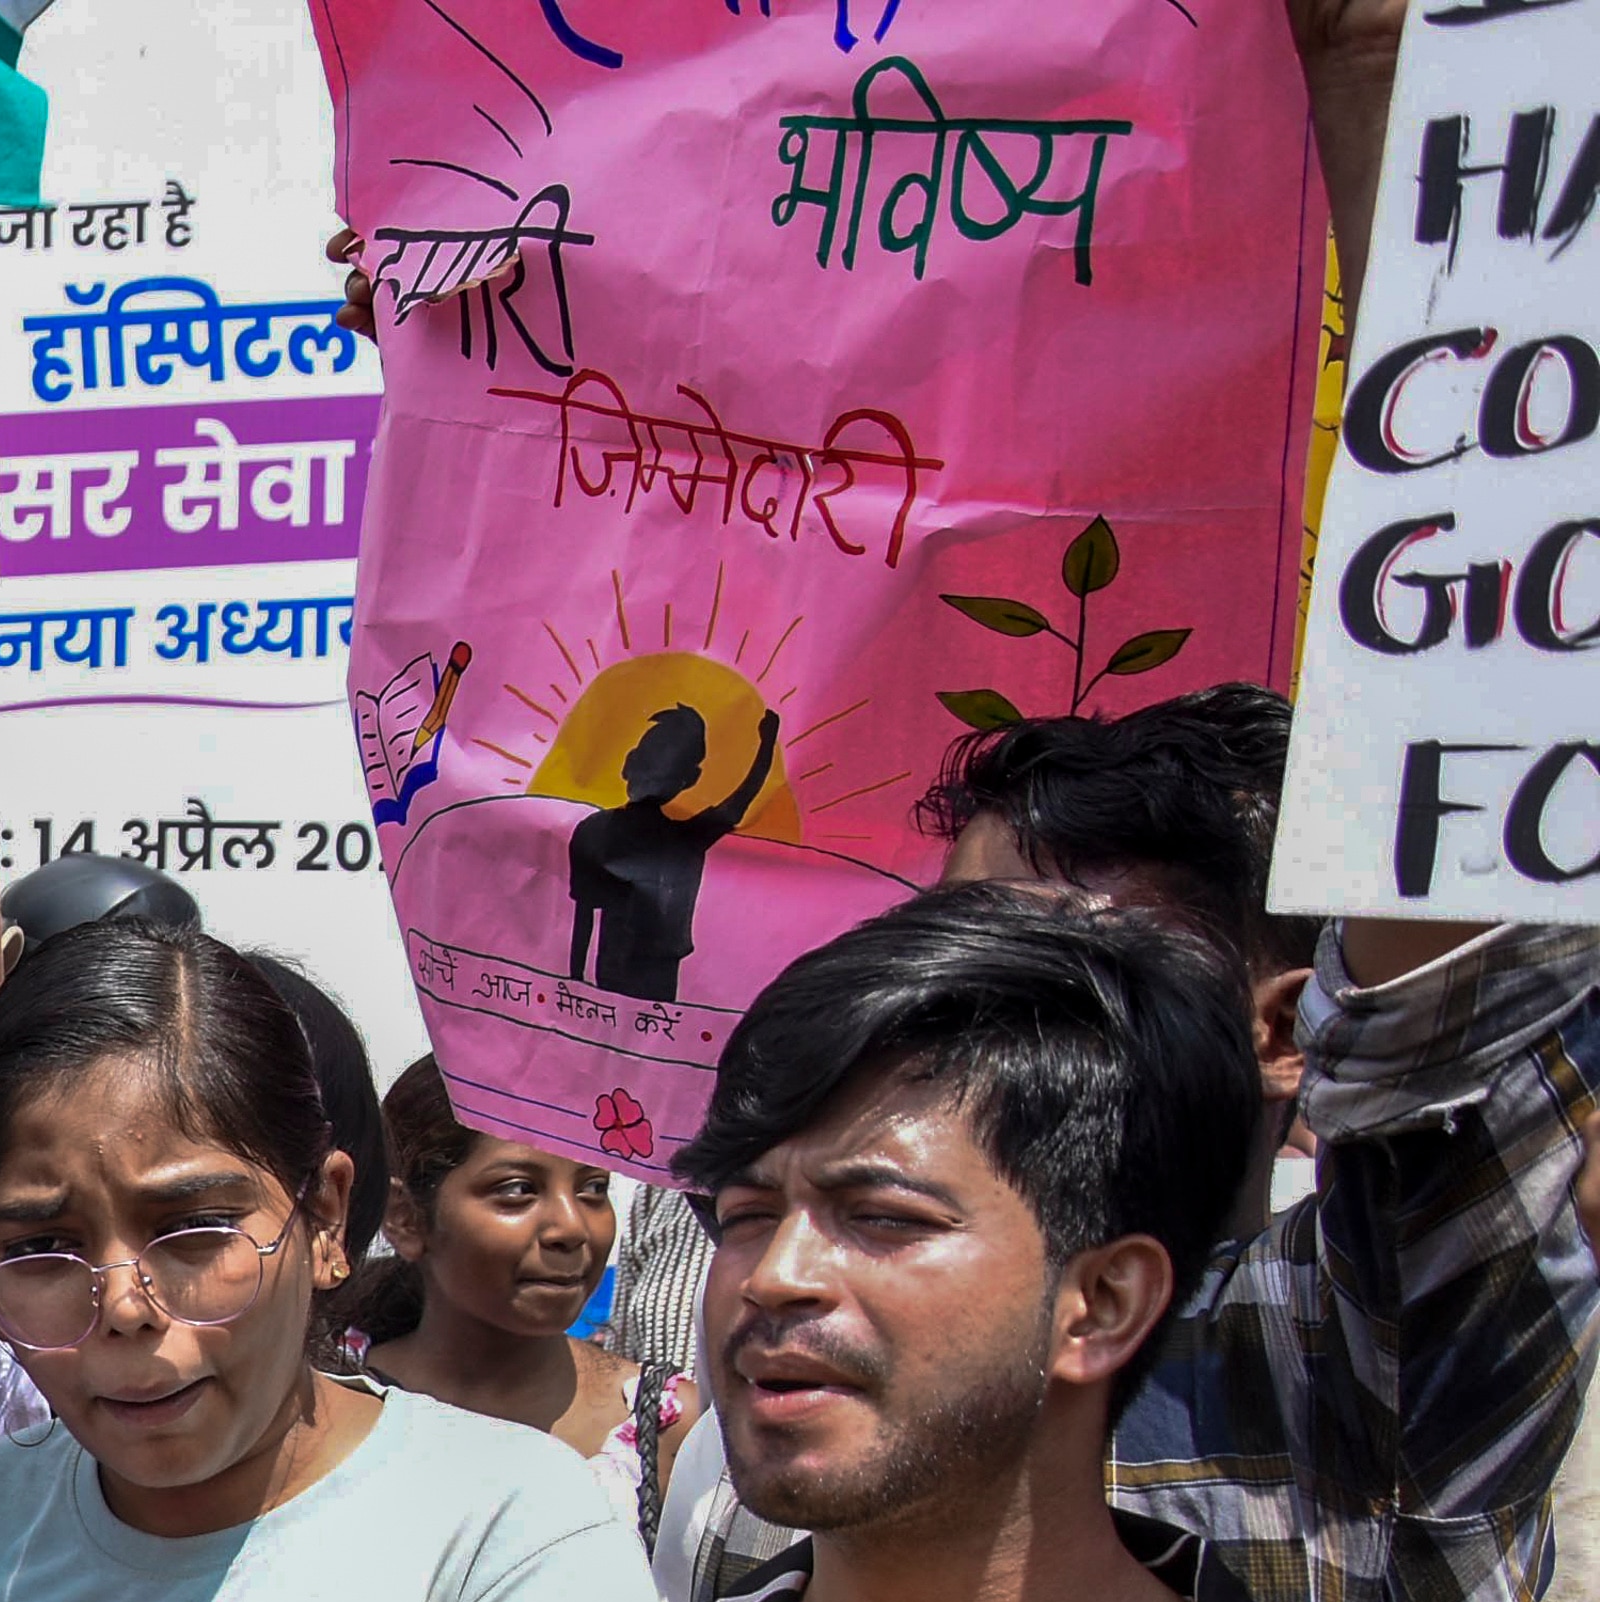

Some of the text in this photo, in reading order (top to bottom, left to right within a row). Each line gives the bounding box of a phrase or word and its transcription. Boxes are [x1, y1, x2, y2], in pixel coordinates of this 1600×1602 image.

[68, 201, 150, 252] रहा
[162, 180, 197, 249] है
[772, 56, 1132, 287] भविष्य
[23, 277, 357, 402] हॉस्पिटल
[155, 418, 356, 534] सेवा
[32, 818, 96, 868] 14
[120, 797, 283, 873] अप्रैल
[296, 819, 386, 873] 20
[471, 972, 534, 1008] आज
[634, 1002, 683, 1042] करें
